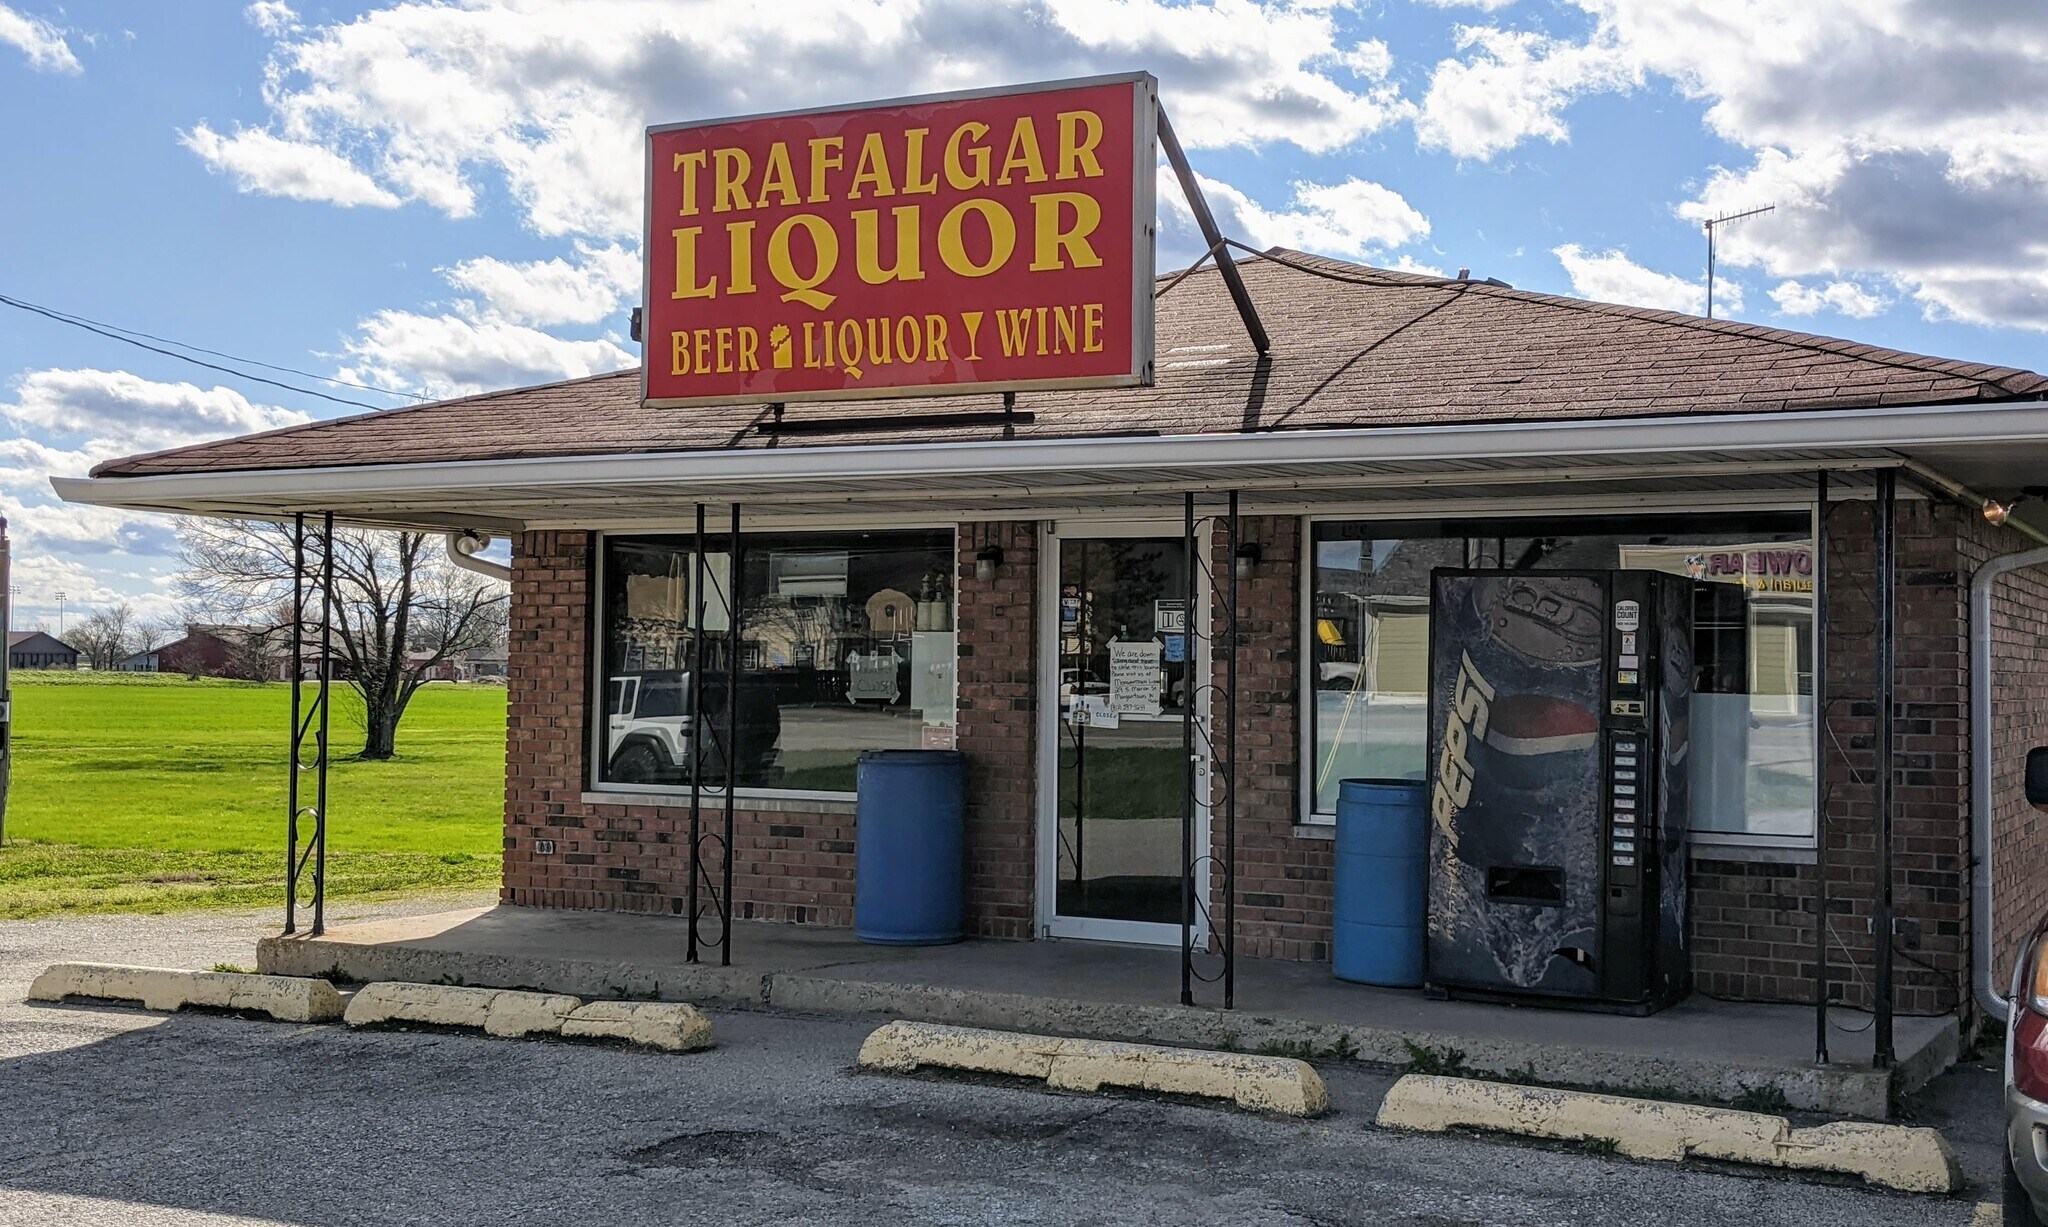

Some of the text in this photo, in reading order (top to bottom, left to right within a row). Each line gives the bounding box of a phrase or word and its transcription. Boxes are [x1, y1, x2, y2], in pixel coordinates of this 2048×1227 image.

[673, 110, 1104, 217] TRAFALGAR
[671, 191, 1103, 311] LIQUOR
[671, 303, 1104, 380] BEER LIQUOR WINE
[1113, 646, 1126, 657] We
[1616, 611, 1638, 619] COUNT
[1431, 647, 1497, 849] PEPSI
